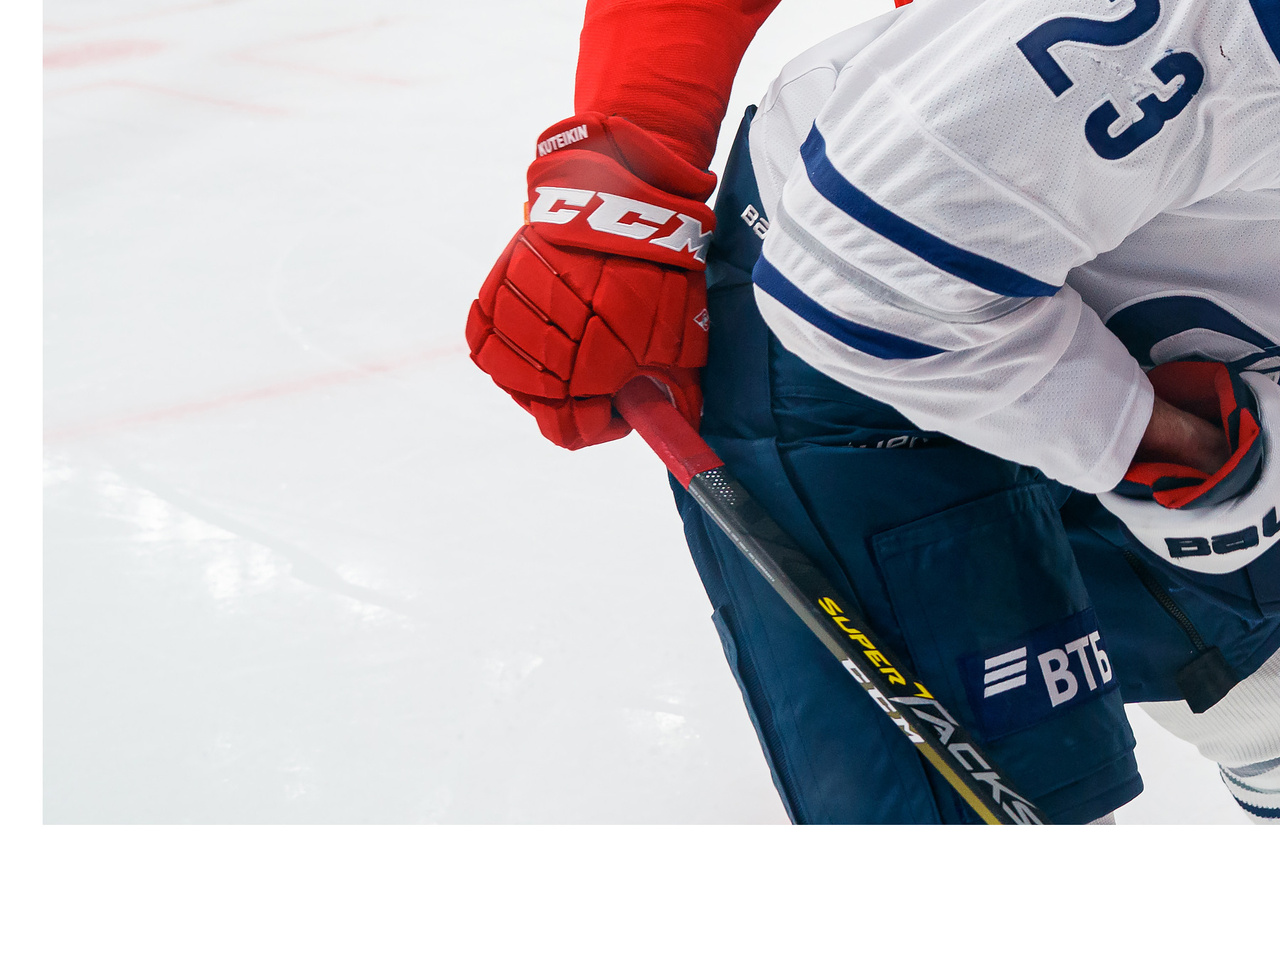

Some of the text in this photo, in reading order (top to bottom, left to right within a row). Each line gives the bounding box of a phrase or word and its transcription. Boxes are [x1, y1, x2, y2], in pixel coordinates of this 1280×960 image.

[537, 124, 588, 157] KUTEIKIN
[529, 185, 714, 265] CCM
[818, 596, 906, 686] SUPER
[1037, 630, 1113, 708] ВТБ
[841, 656, 925, 744] CCM
